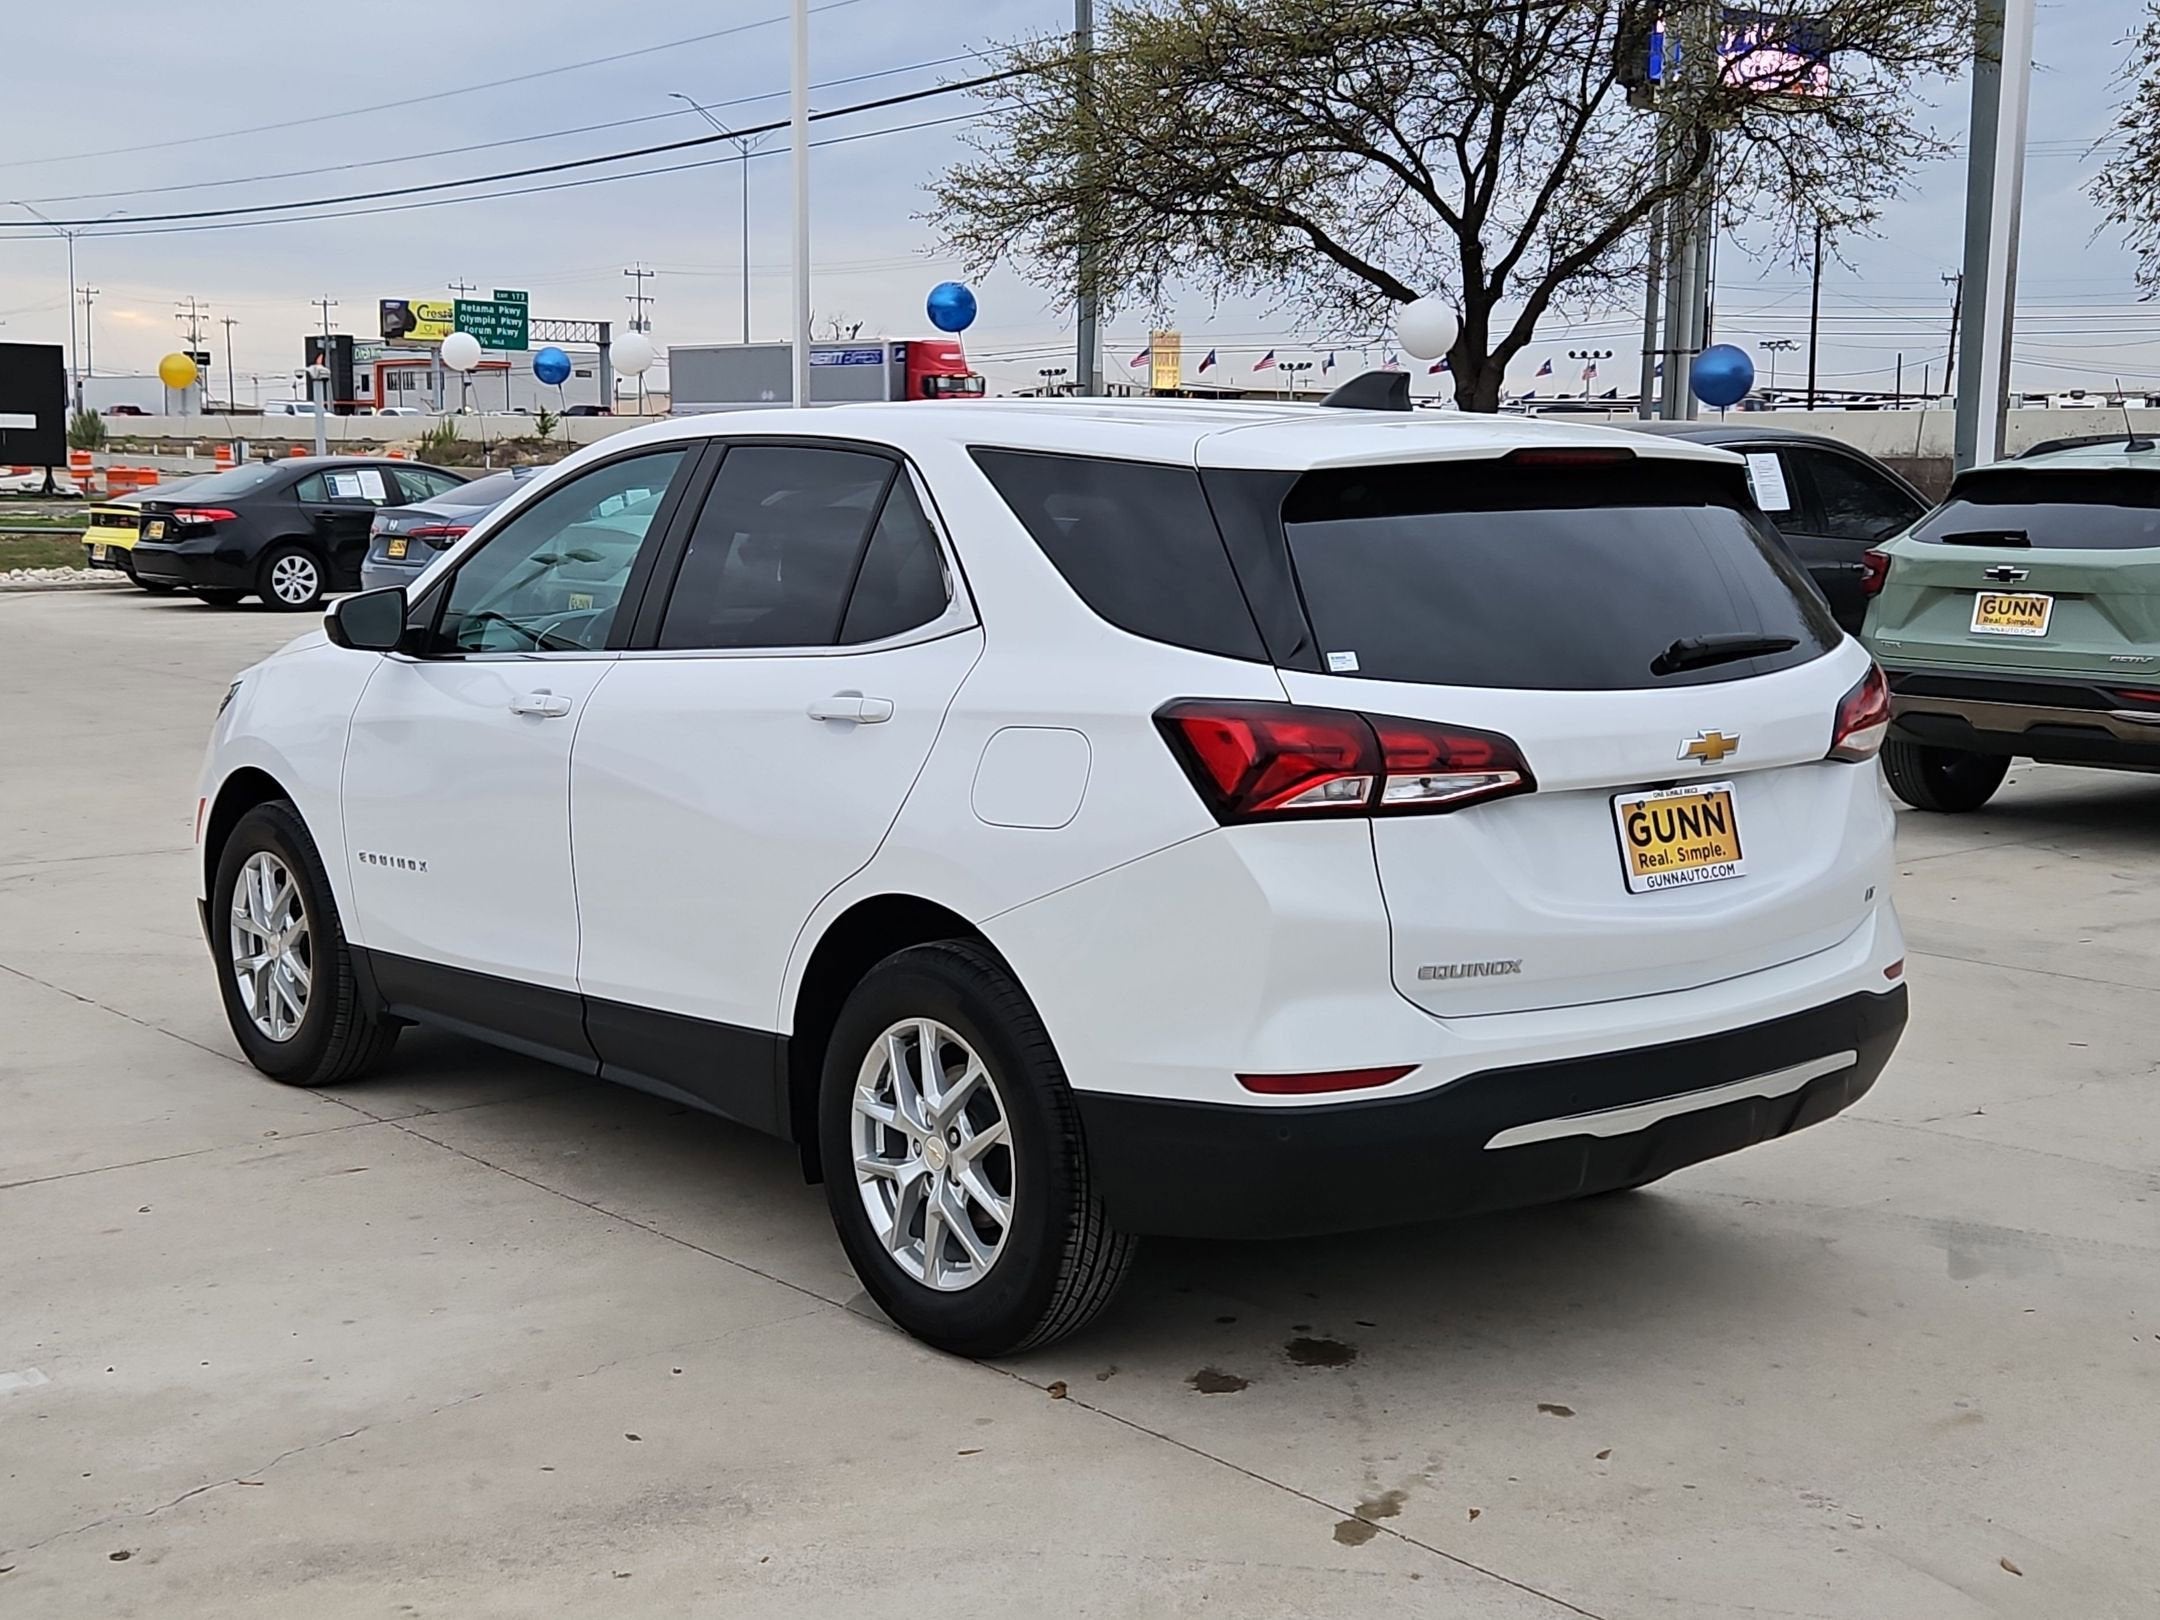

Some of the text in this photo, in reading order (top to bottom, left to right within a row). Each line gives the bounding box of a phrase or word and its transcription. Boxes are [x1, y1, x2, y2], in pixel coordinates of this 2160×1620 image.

[511, 292, 526, 301] 173
[461, 303, 521, 317] Retama Pkwy
[459, 314, 523, 329] Olympia Pkwy
[464, 325, 519, 339] Forum Pkwy
[1983, 599, 2045, 617] GUNN
[1982, 615, 2038, 627] Real. Simple.
[1627, 801, 1727, 847] GUNN
[358, 852, 428, 873] EQUINOX
[1638, 842, 1727, 869] Real. Simple.
[1646, 863, 1736, 888] GUNNAUTO.COM
[1417, 959, 1523, 981] EQUINOX
